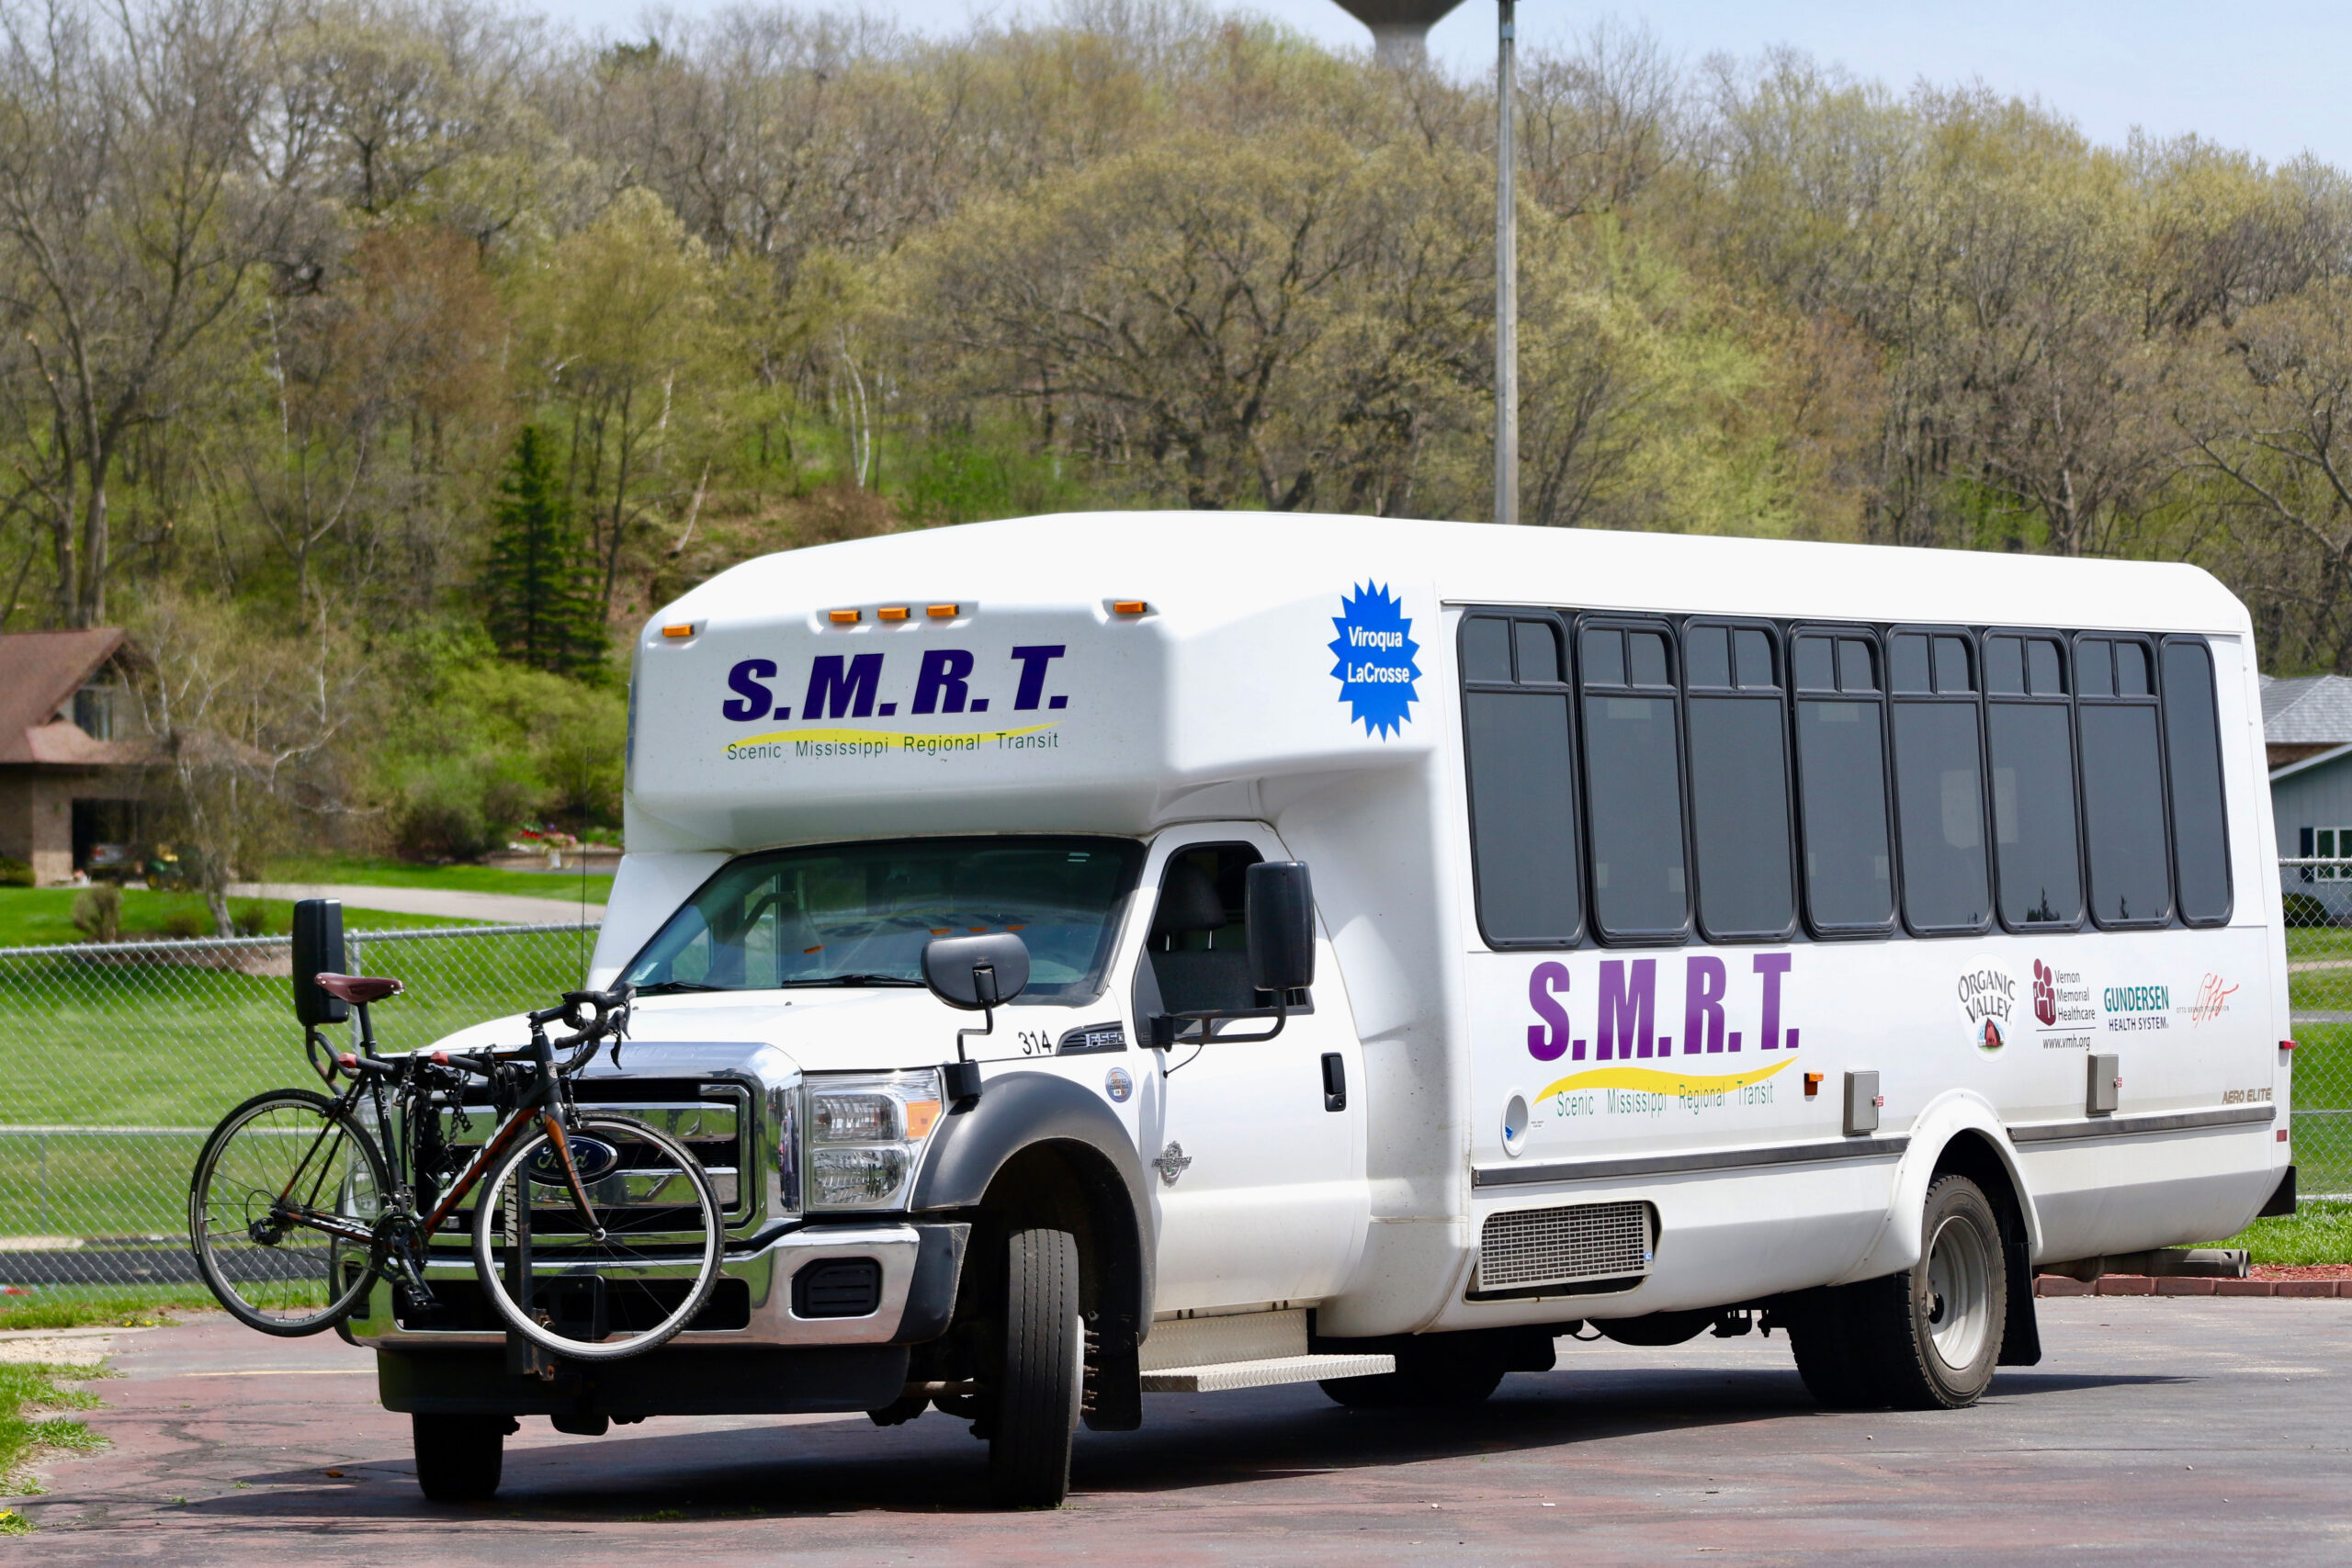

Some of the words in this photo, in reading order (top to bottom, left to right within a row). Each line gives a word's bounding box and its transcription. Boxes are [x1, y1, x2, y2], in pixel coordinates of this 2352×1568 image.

[1348, 626, 1403, 653] Viroqua
[722, 645, 1069, 722] S.M.R.T.
[1347, 662, 1410, 683] LaCrosse
[727, 741, 782, 761] Scenic
[796, 737, 889, 759] Mississippi
[904, 733, 981, 755] Regional
[996, 731, 1060, 750] Transit
[1958, 970, 2016, 1003] ORGANIC
[2054, 969, 2081, 984] Vernon
[1527, 953, 1800, 1062] S.M.R.T.
[2057, 987, 2090, 1003] Memorial
[2104, 986, 2170, 1012] GUNDERSEN
[1965, 995, 2012, 1024] VALLEY
[2058, 1006, 2096, 1021] Healthcare
[2109, 1018, 2136, 1032] HEALTH
[1018, 1030, 1052, 1055] 314
[2043, 1033, 2091, 1052] www.vmh.org
[1556, 1089, 1595, 1117] Scenic
[1607, 1085, 1668, 1118] Mississippi
[1679, 1082, 1726, 1115] Regional
[1736, 1080, 1774, 1106] Transit
[2222, 1089, 2245, 1105] AERO
[2246, 1088, 2272, 1102] ELITE
[504, 1167, 518, 1247] AKIMA
